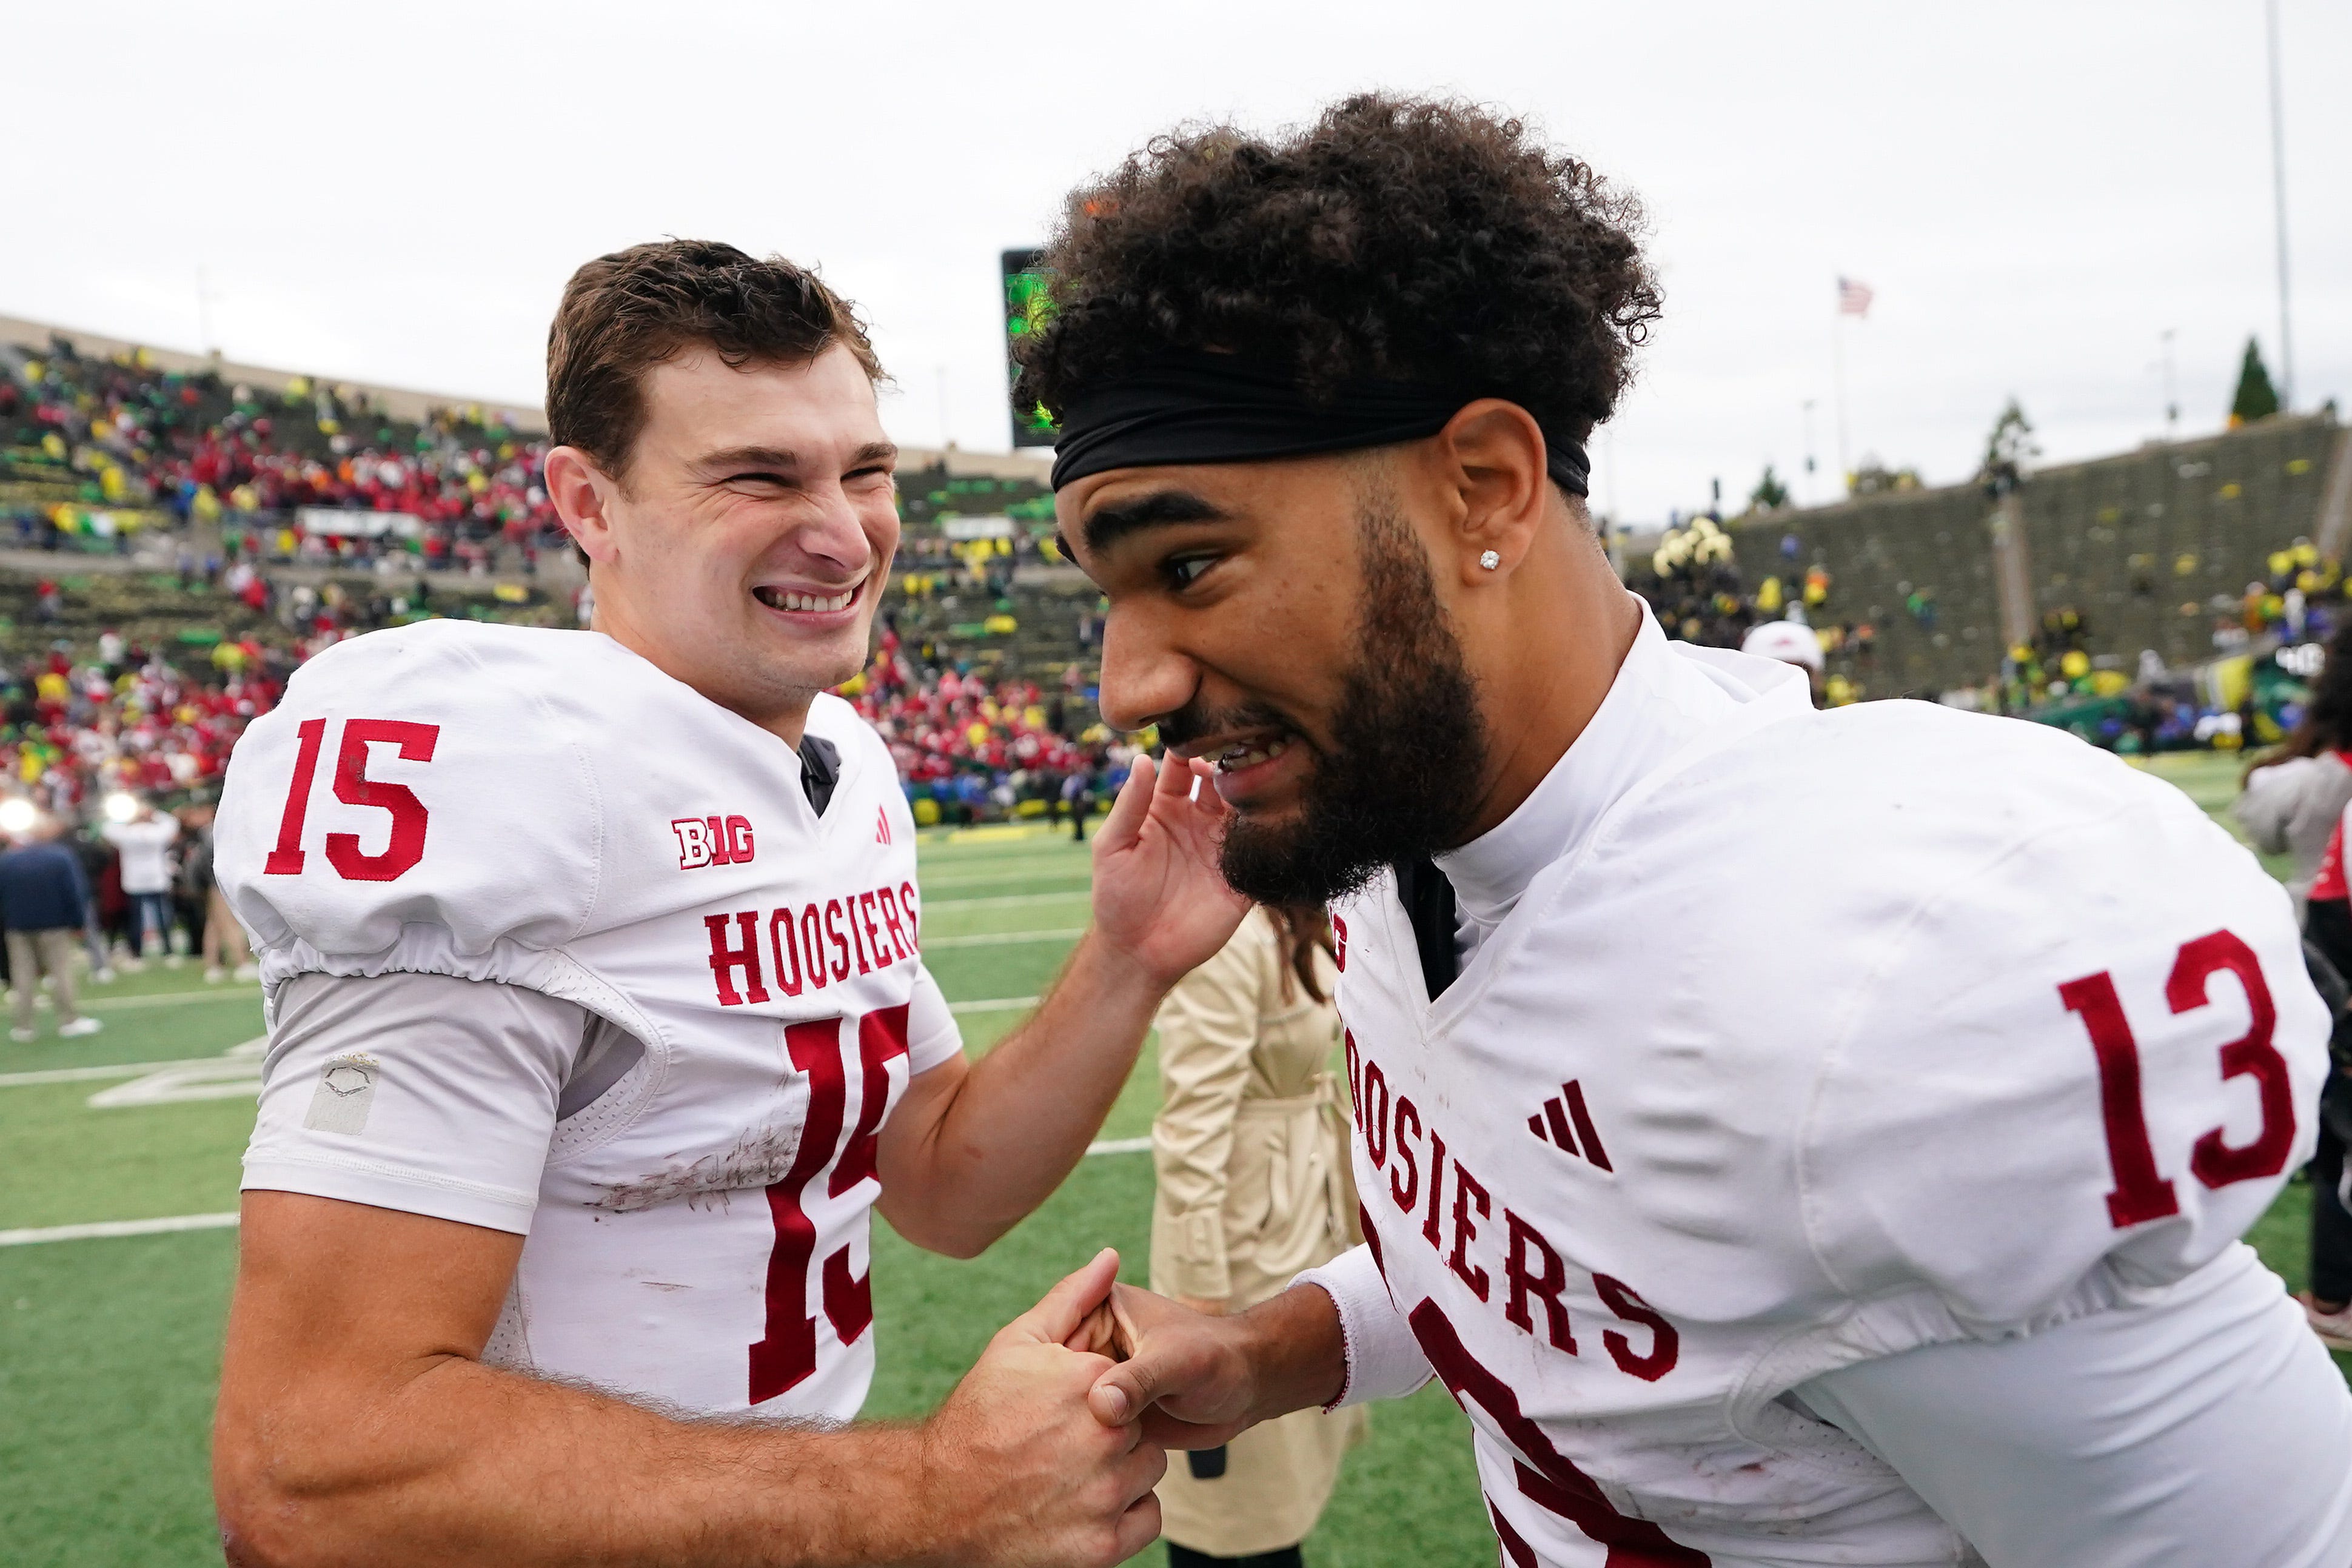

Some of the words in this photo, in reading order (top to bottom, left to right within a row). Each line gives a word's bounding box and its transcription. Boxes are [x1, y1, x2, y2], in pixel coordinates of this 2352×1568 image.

[263, 717, 440, 882] 15
[703, 881, 918, 1007] HOOSIERS
[2057, 928, 2297, 1230] 13
[1338, 1025, 1679, 1382] OOSIERS
